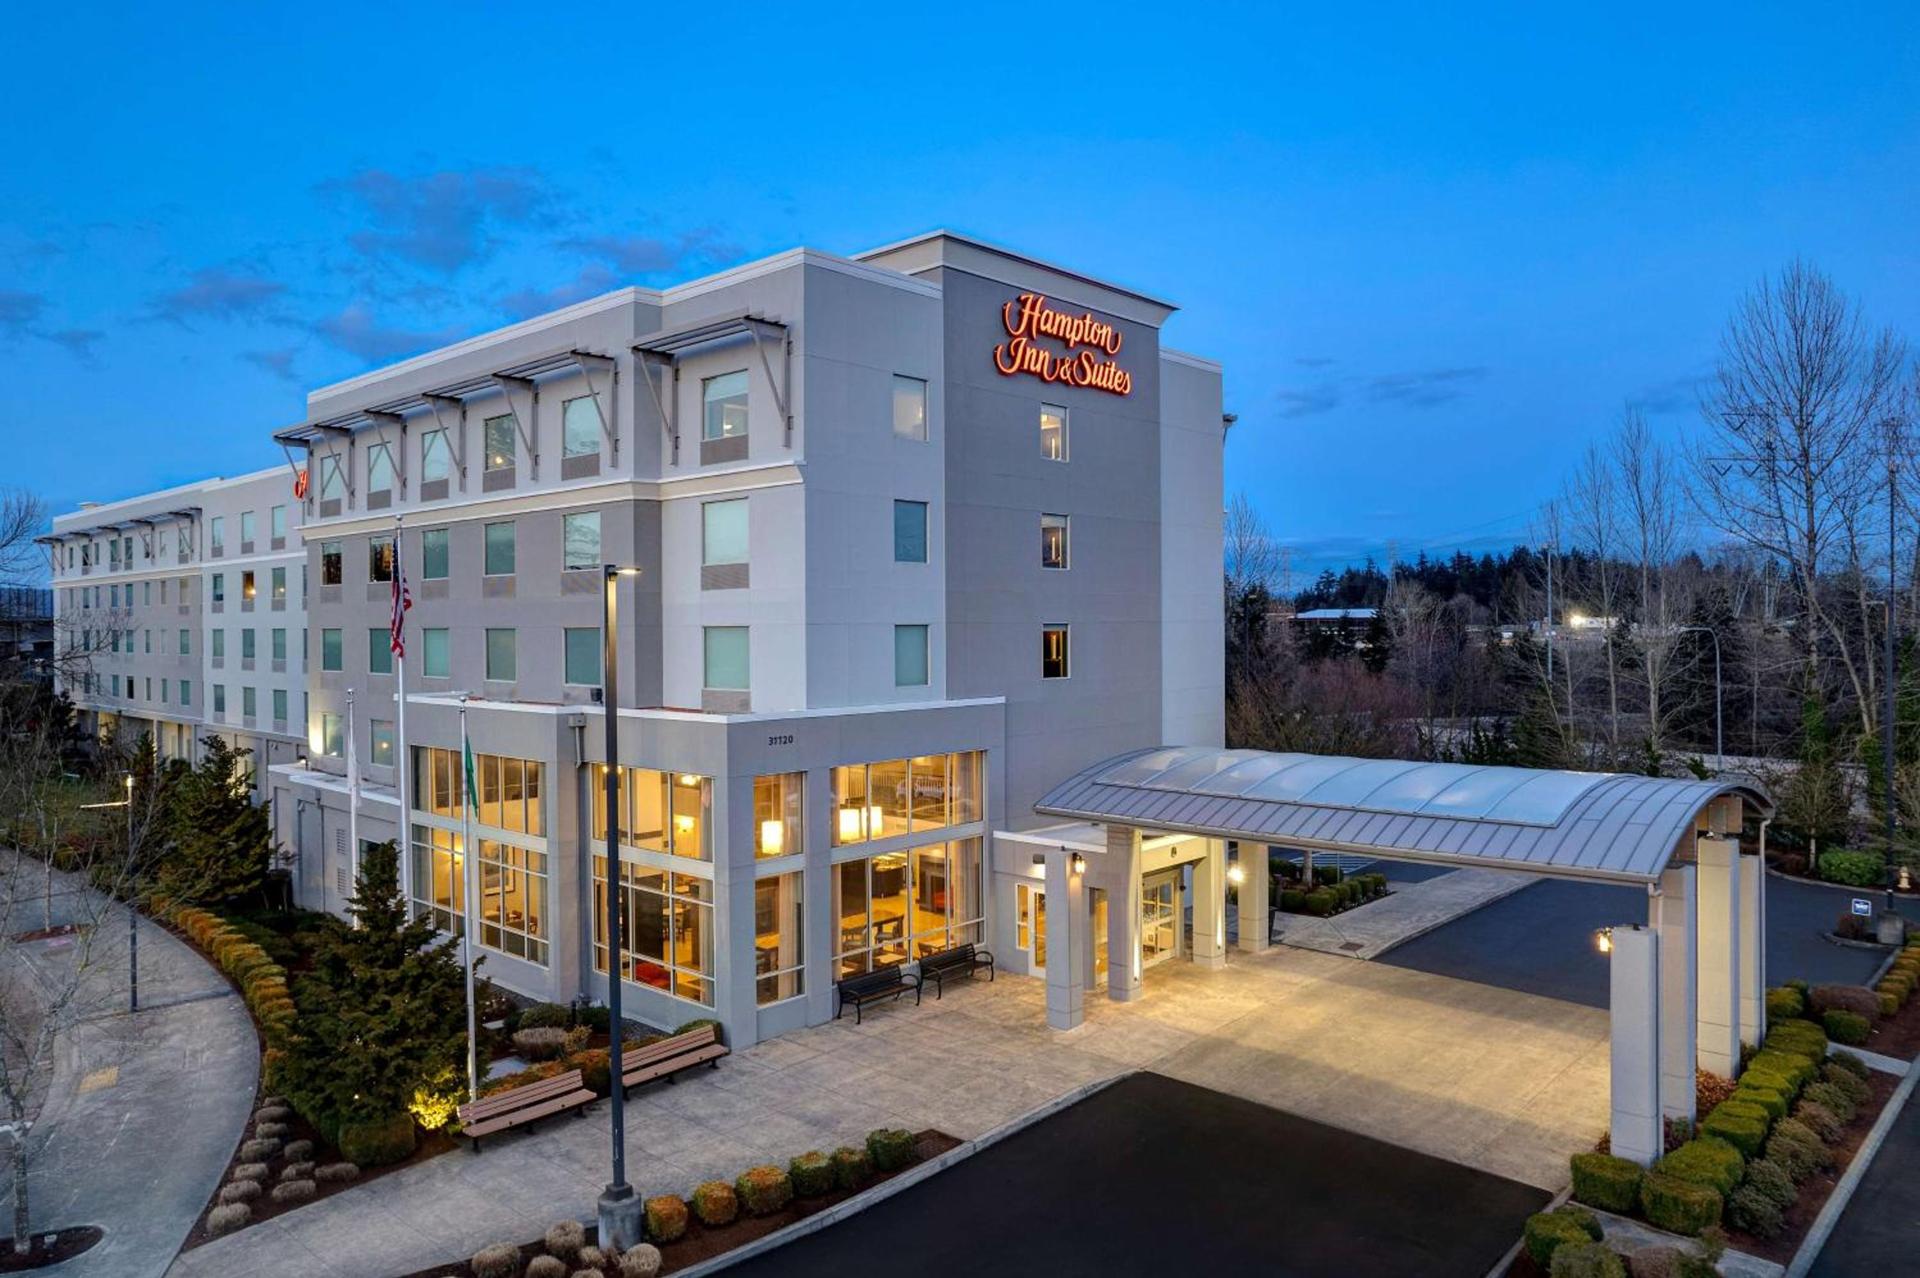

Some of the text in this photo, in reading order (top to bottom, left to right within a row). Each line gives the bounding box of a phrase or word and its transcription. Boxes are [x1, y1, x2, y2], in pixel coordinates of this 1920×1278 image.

[1002, 293, 1122, 354] Hampton
[993, 337, 1132, 394] Inn & Suites
